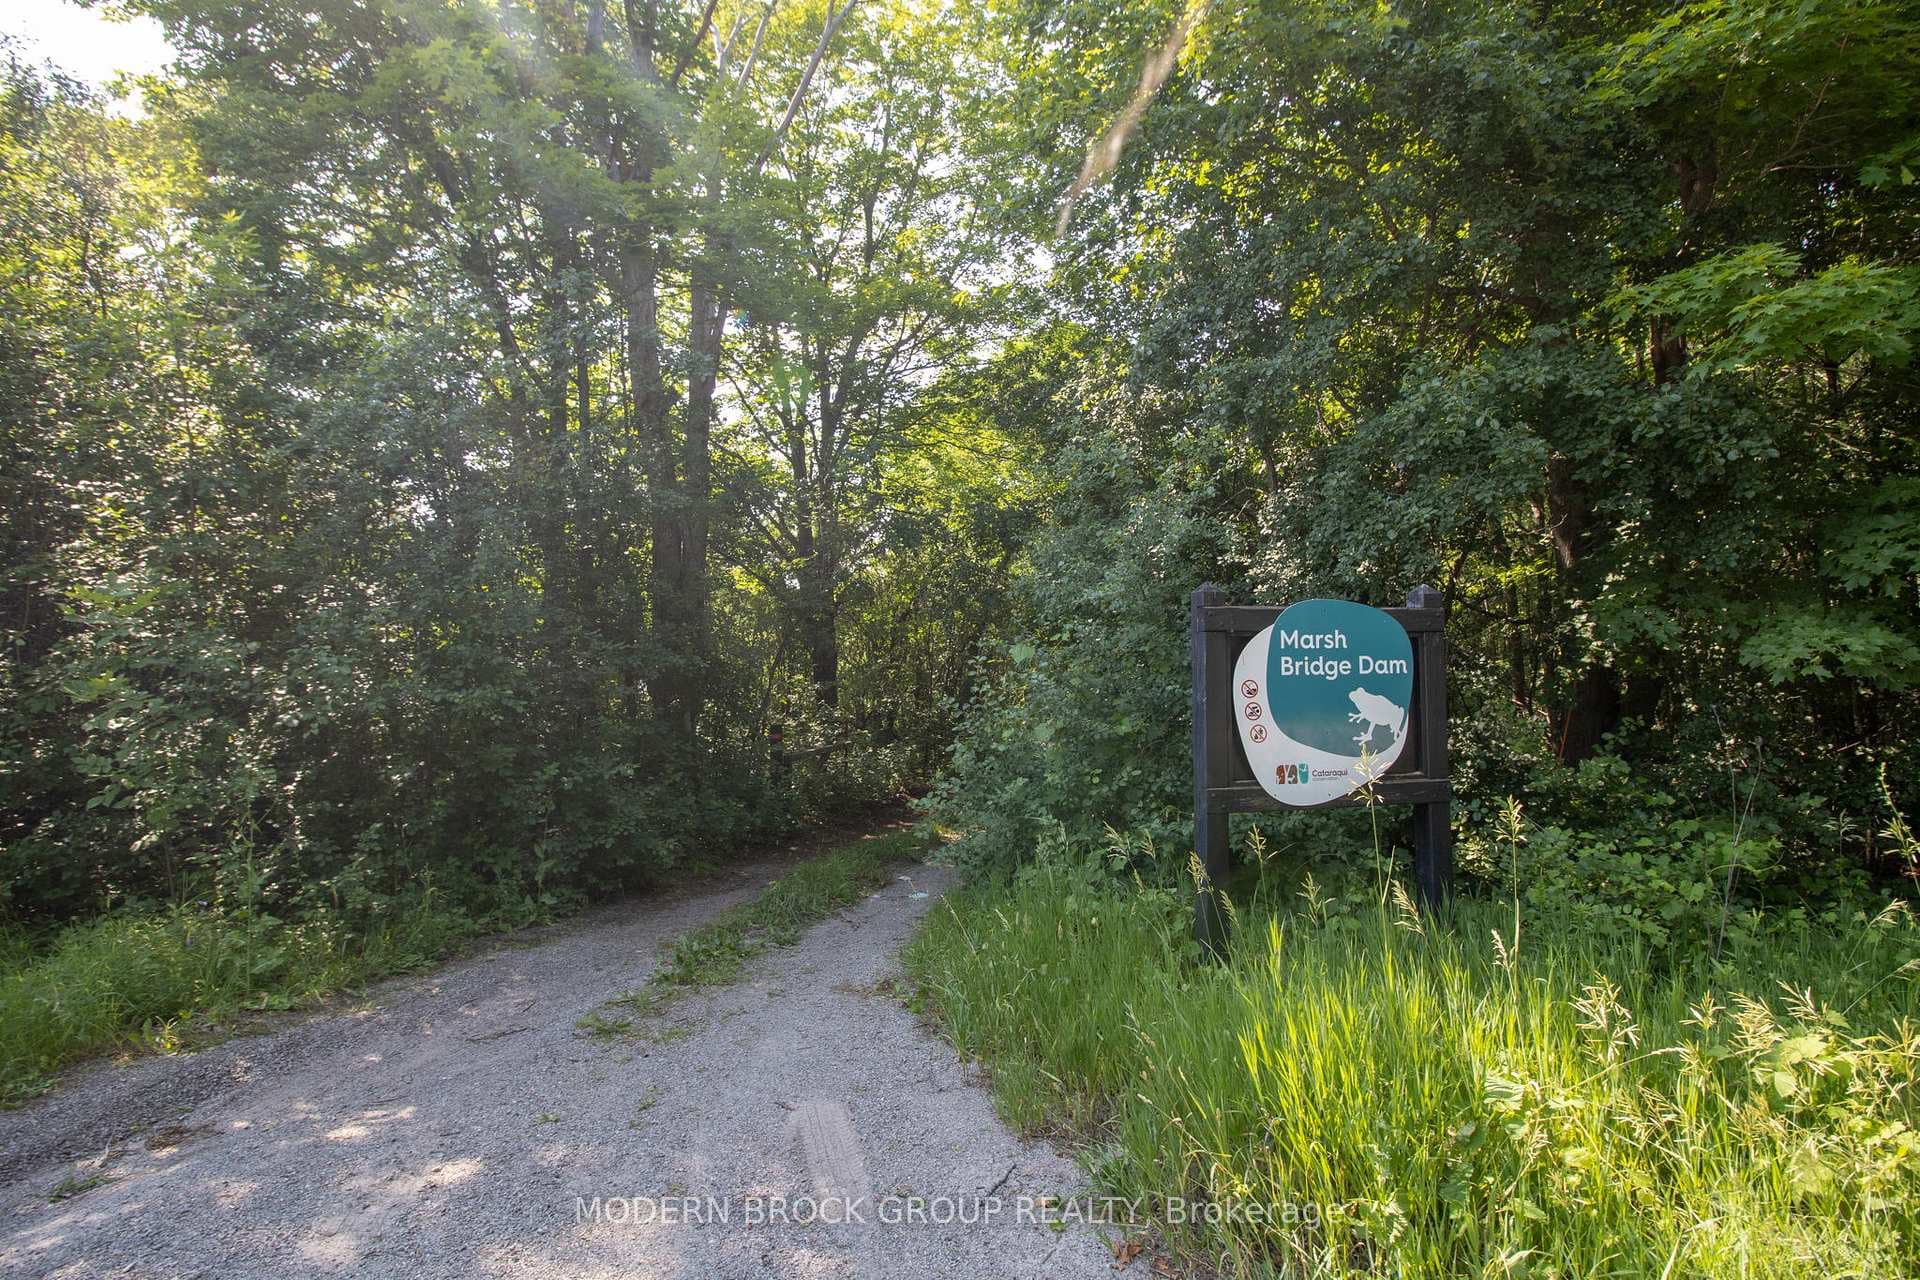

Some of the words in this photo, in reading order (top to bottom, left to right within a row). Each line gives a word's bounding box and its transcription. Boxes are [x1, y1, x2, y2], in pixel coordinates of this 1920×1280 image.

[1280, 629, 1347, 649] Marsh
[1280, 656, 1351, 680] Bridge
[1359, 656, 1408, 674] Dam
[1312, 768, 1348, 778] Cataraqui
